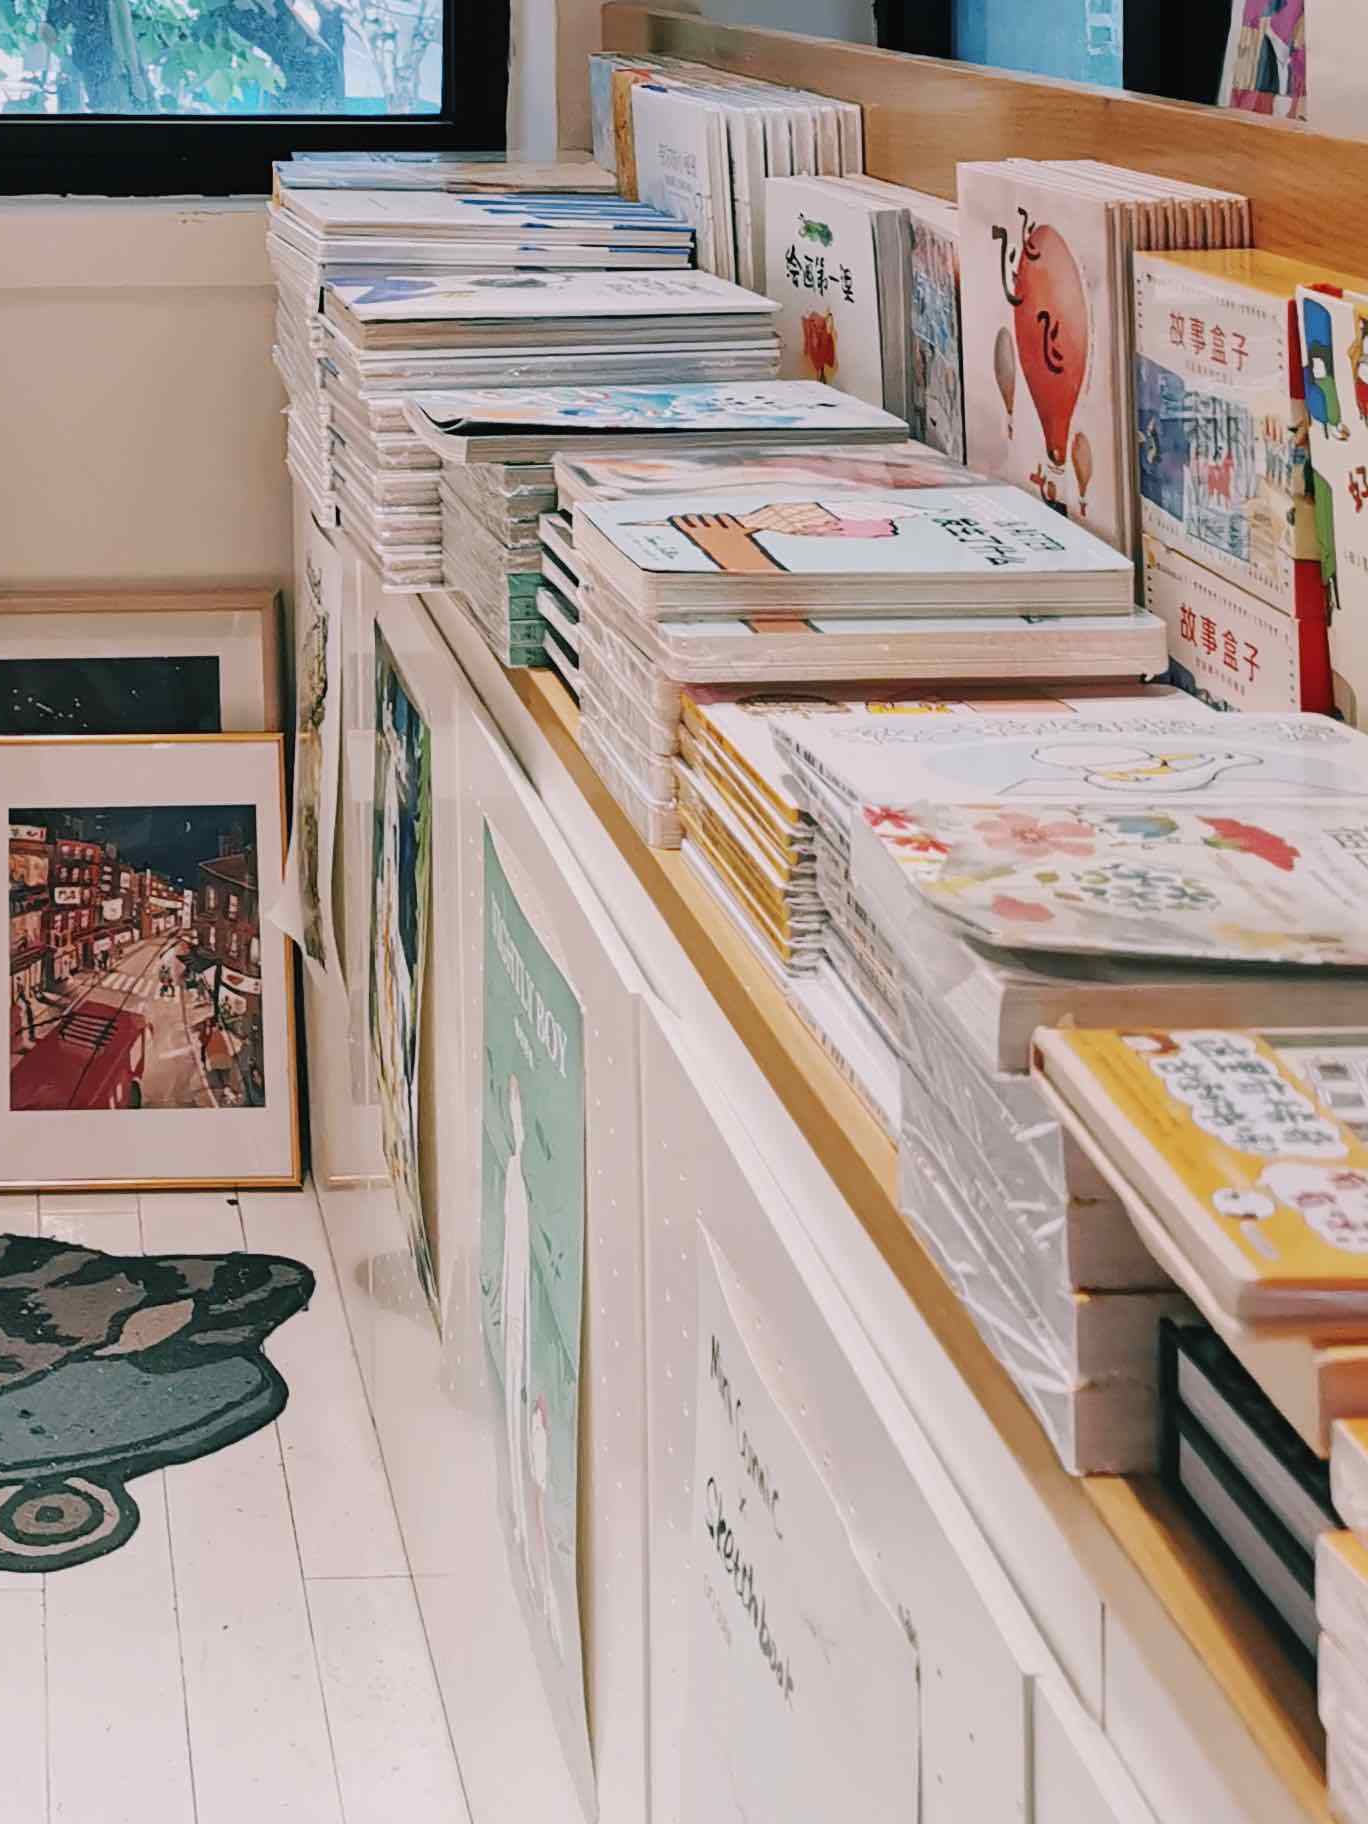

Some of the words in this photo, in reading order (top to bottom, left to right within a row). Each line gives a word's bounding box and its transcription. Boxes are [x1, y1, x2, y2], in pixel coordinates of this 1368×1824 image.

[1169, 312, 1248, 372] 故事盒子
[1180, 603, 1261, 683] 故事盒子
